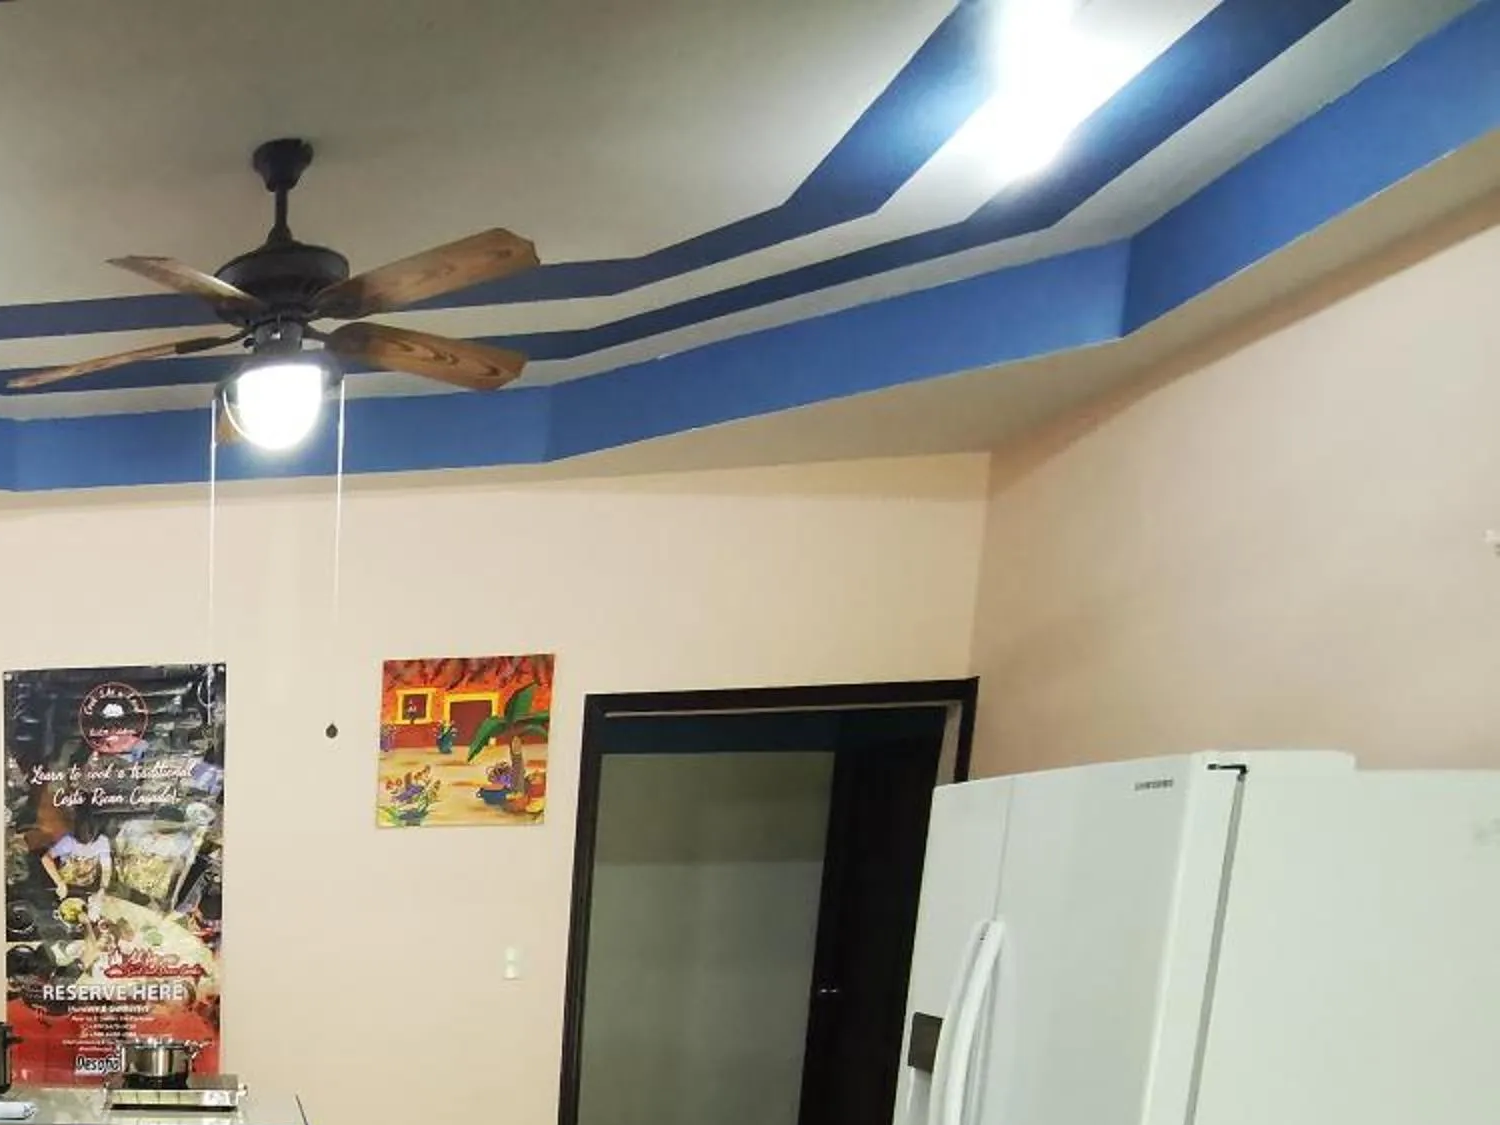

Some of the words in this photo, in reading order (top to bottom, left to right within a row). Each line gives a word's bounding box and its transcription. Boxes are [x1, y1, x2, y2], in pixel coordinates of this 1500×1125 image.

[30, 764, 64, 785] Learn
[69, 763, 82, 780] to
[87, 763, 113, 779] cook
[53, 788, 86, 807] Costa
[92, 787, 125, 806] Rican
[42, 984, 127, 1001] RESERVE
[133, 983, 185, 1001] HERE
